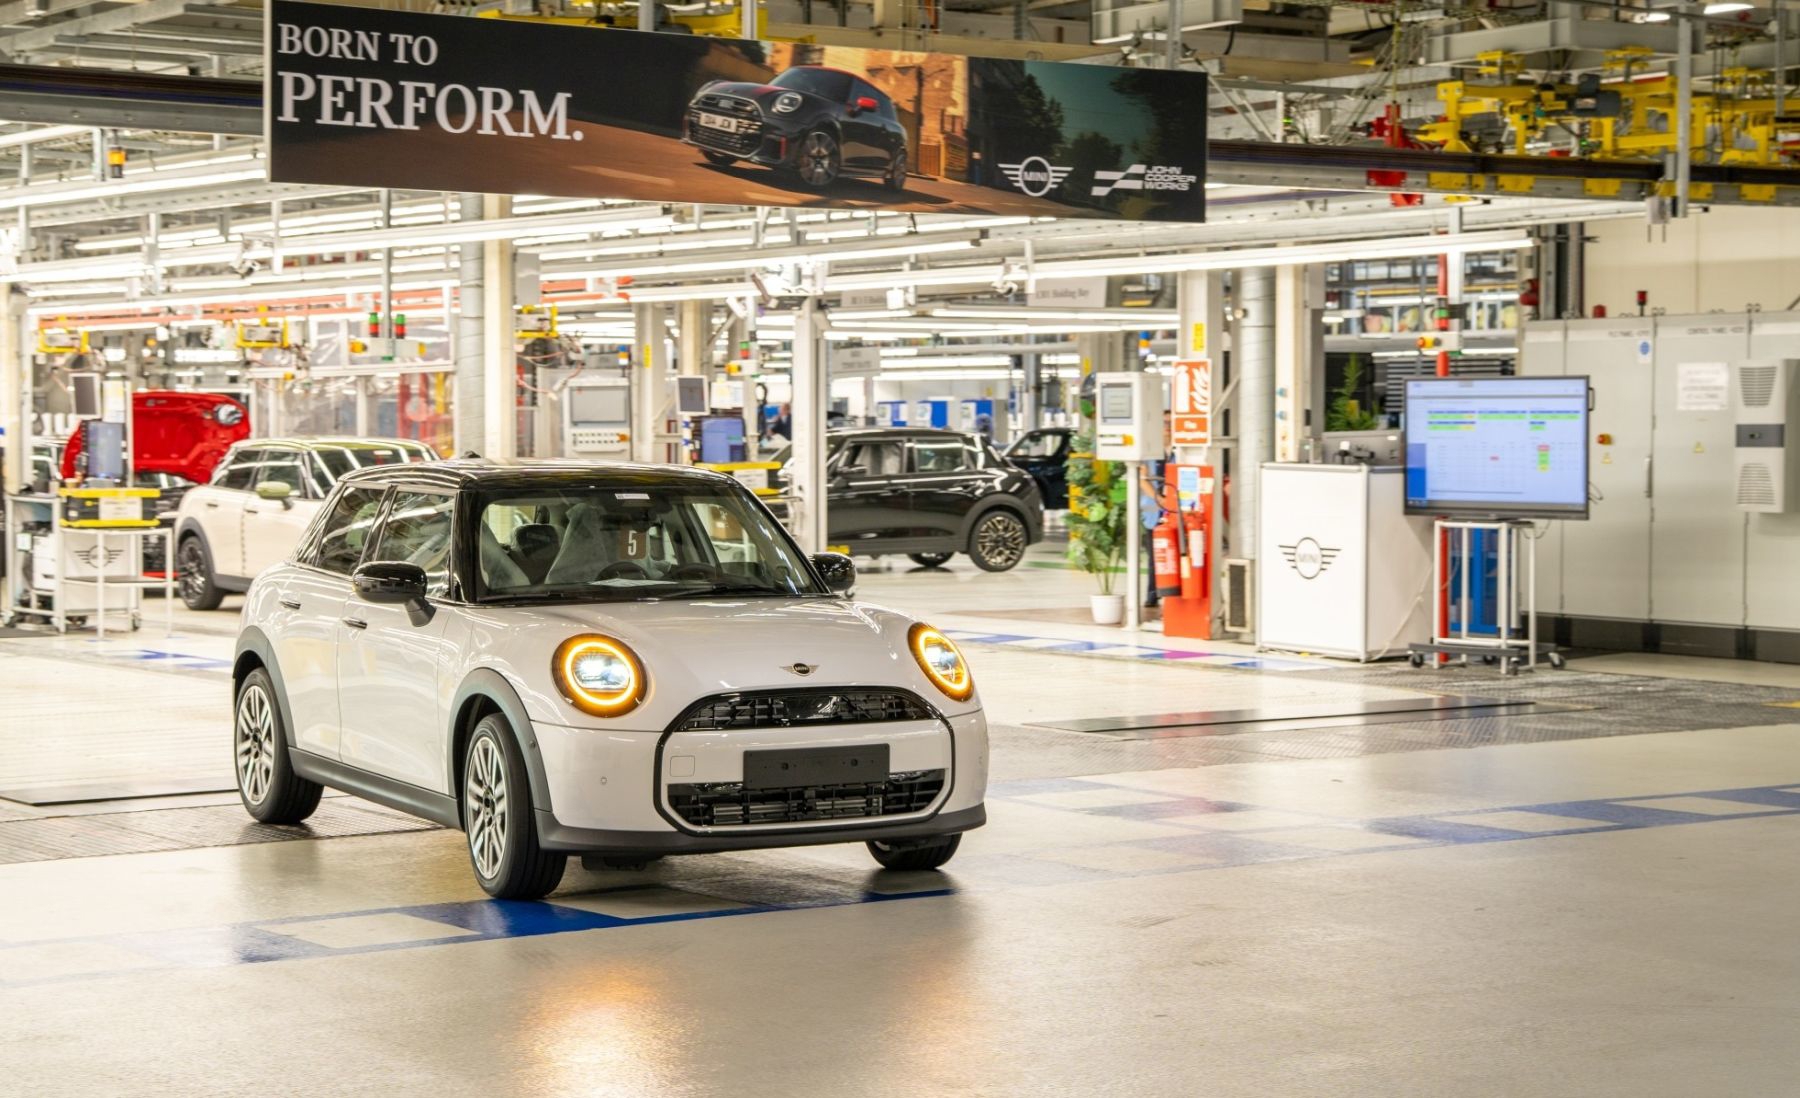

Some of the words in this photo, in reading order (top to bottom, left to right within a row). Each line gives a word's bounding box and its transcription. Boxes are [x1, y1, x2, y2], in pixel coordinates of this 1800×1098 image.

[277, 23, 381, 61] BORN
[389, 33, 438, 66] TO
[277, 71, 584, 141] PERFORM.
[1146, 165, 1182, 175] JOHN
[1022, 171, 1049, 182] MINI
[1145, 174, 1197, 183] COOPER
[1144, 181, 1189, 191] WORKS
[628, 530, 637, 556] 5
